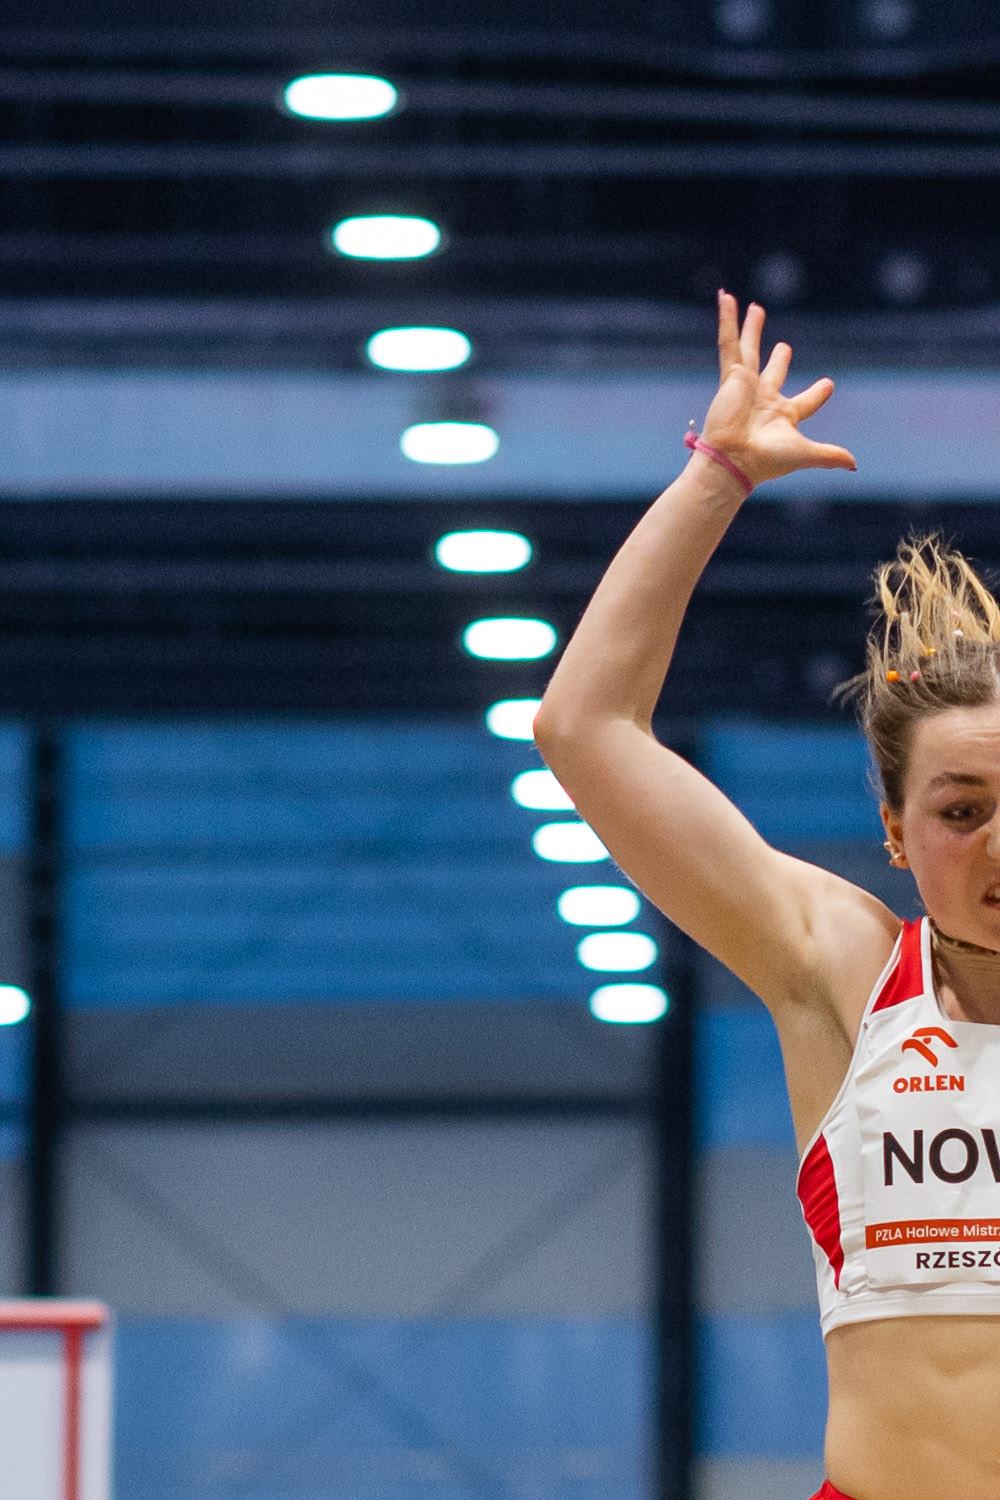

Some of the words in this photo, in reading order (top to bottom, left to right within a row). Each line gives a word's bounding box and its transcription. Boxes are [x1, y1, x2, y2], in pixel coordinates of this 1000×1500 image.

[892, 1074, 966, 1094] ORLEN
[874, 1227, 904, 1242] PZLA
[905, 1224, 960, 1239] Halowe
